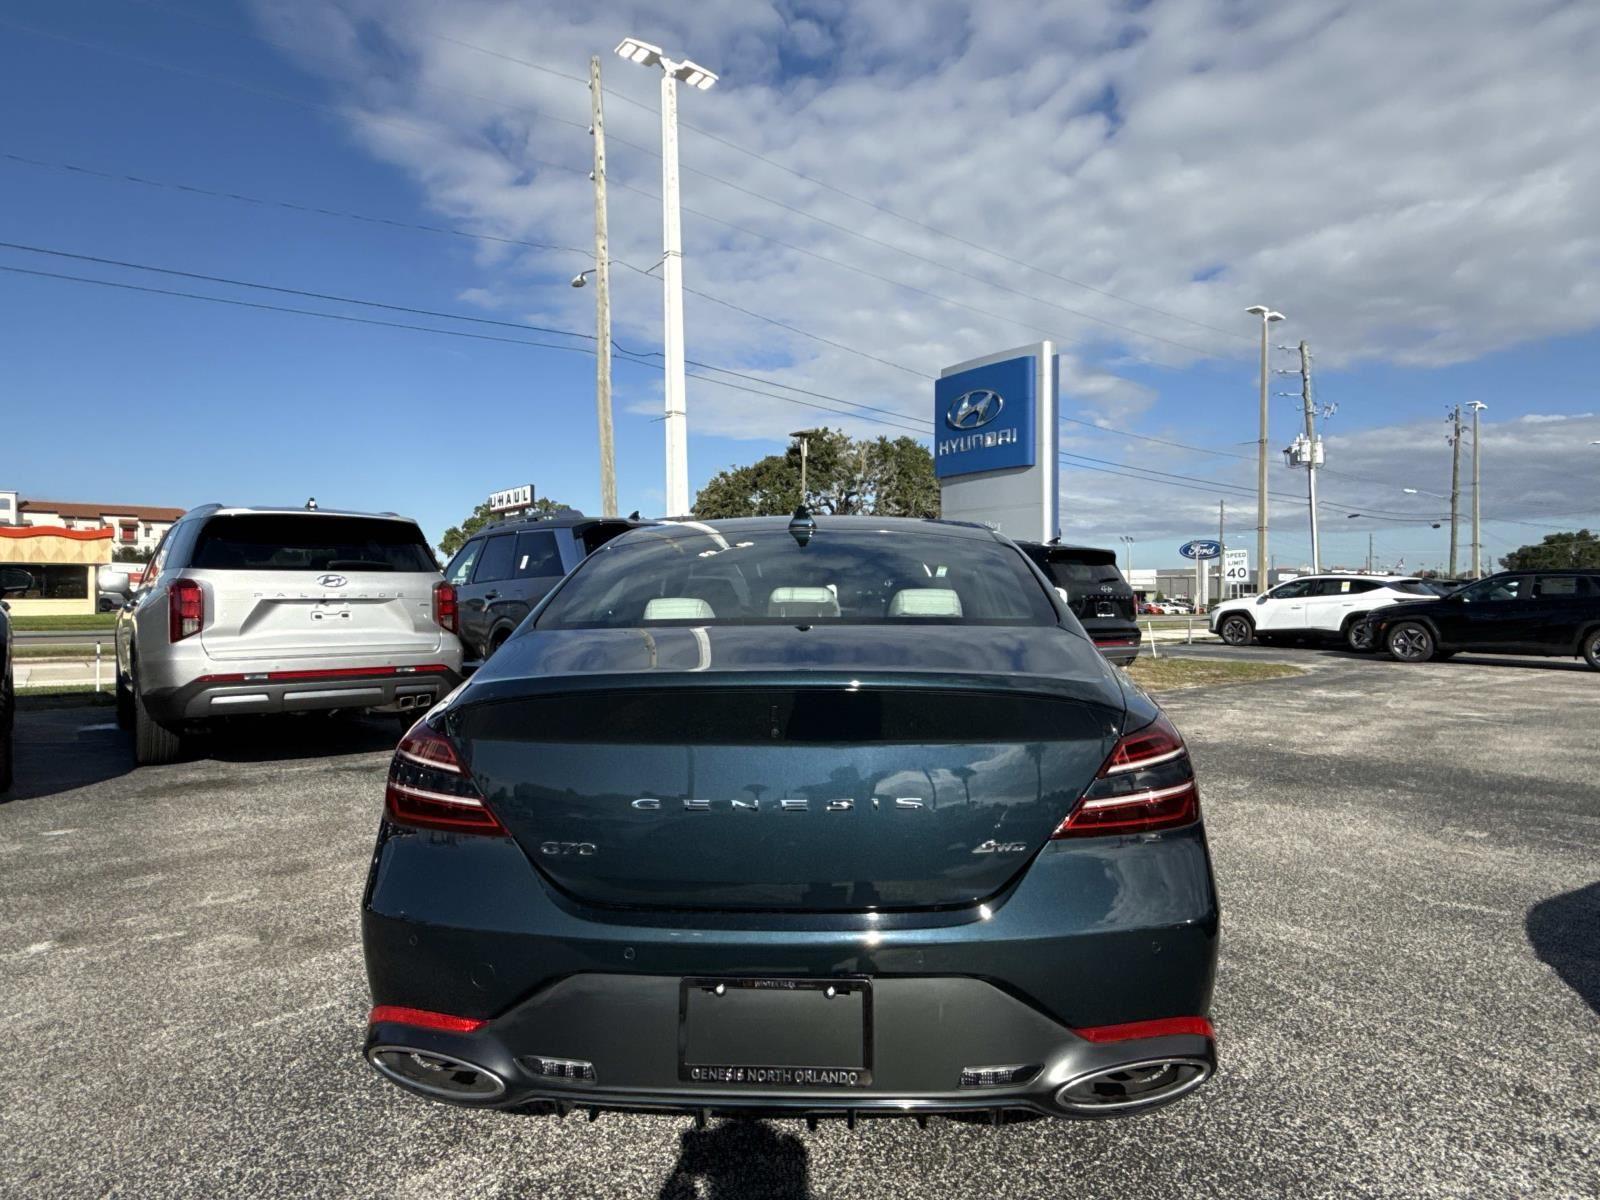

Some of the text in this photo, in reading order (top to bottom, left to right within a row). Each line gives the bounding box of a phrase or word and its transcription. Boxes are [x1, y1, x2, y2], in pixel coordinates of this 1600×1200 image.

[939, 428, 1017, 456] HYUNDAI
[1188, 543, 1216, 556] Ford
[1227, 567, 1247, 578] 40
[631, 798, 923, 811] GENESIS
[541, 841, 596, 855] G70
[691, 1068, 858, 1085] GENESIS NORTH ORLANDO
